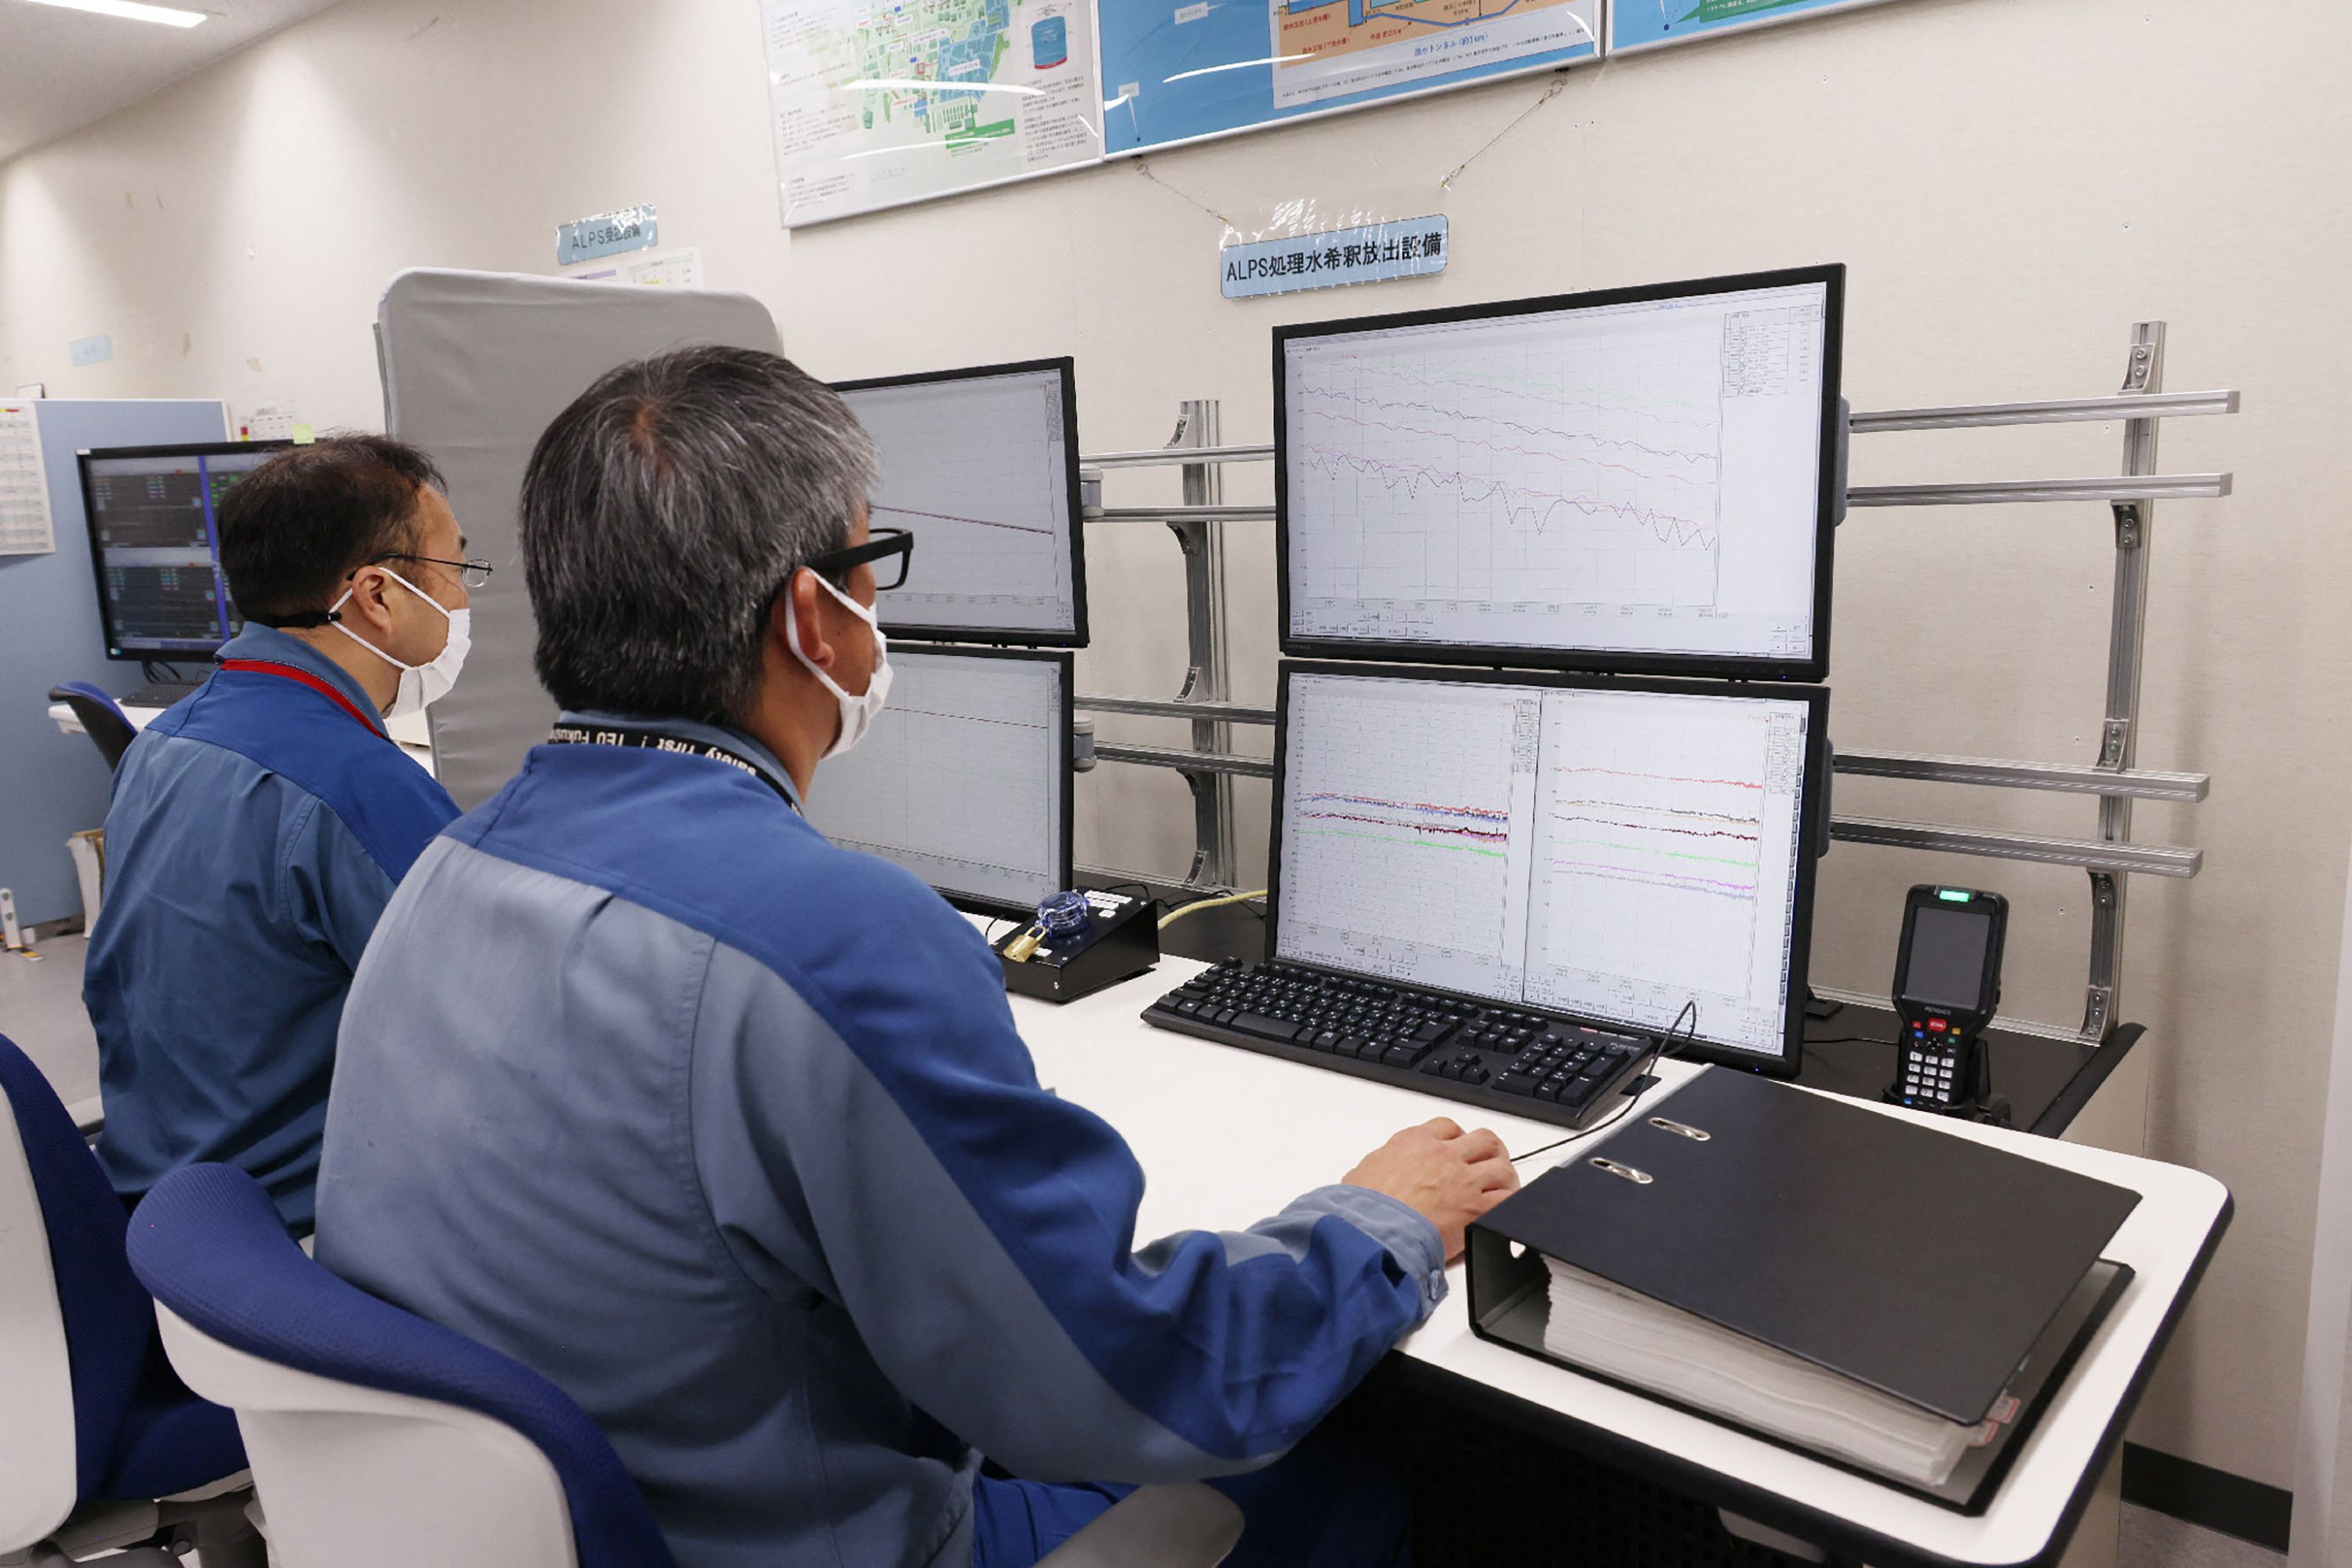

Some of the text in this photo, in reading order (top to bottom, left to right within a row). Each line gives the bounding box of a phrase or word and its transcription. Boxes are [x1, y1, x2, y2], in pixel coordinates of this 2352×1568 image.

[1226, 231, 1443, 281] ALPS処理水希釈放出設備
